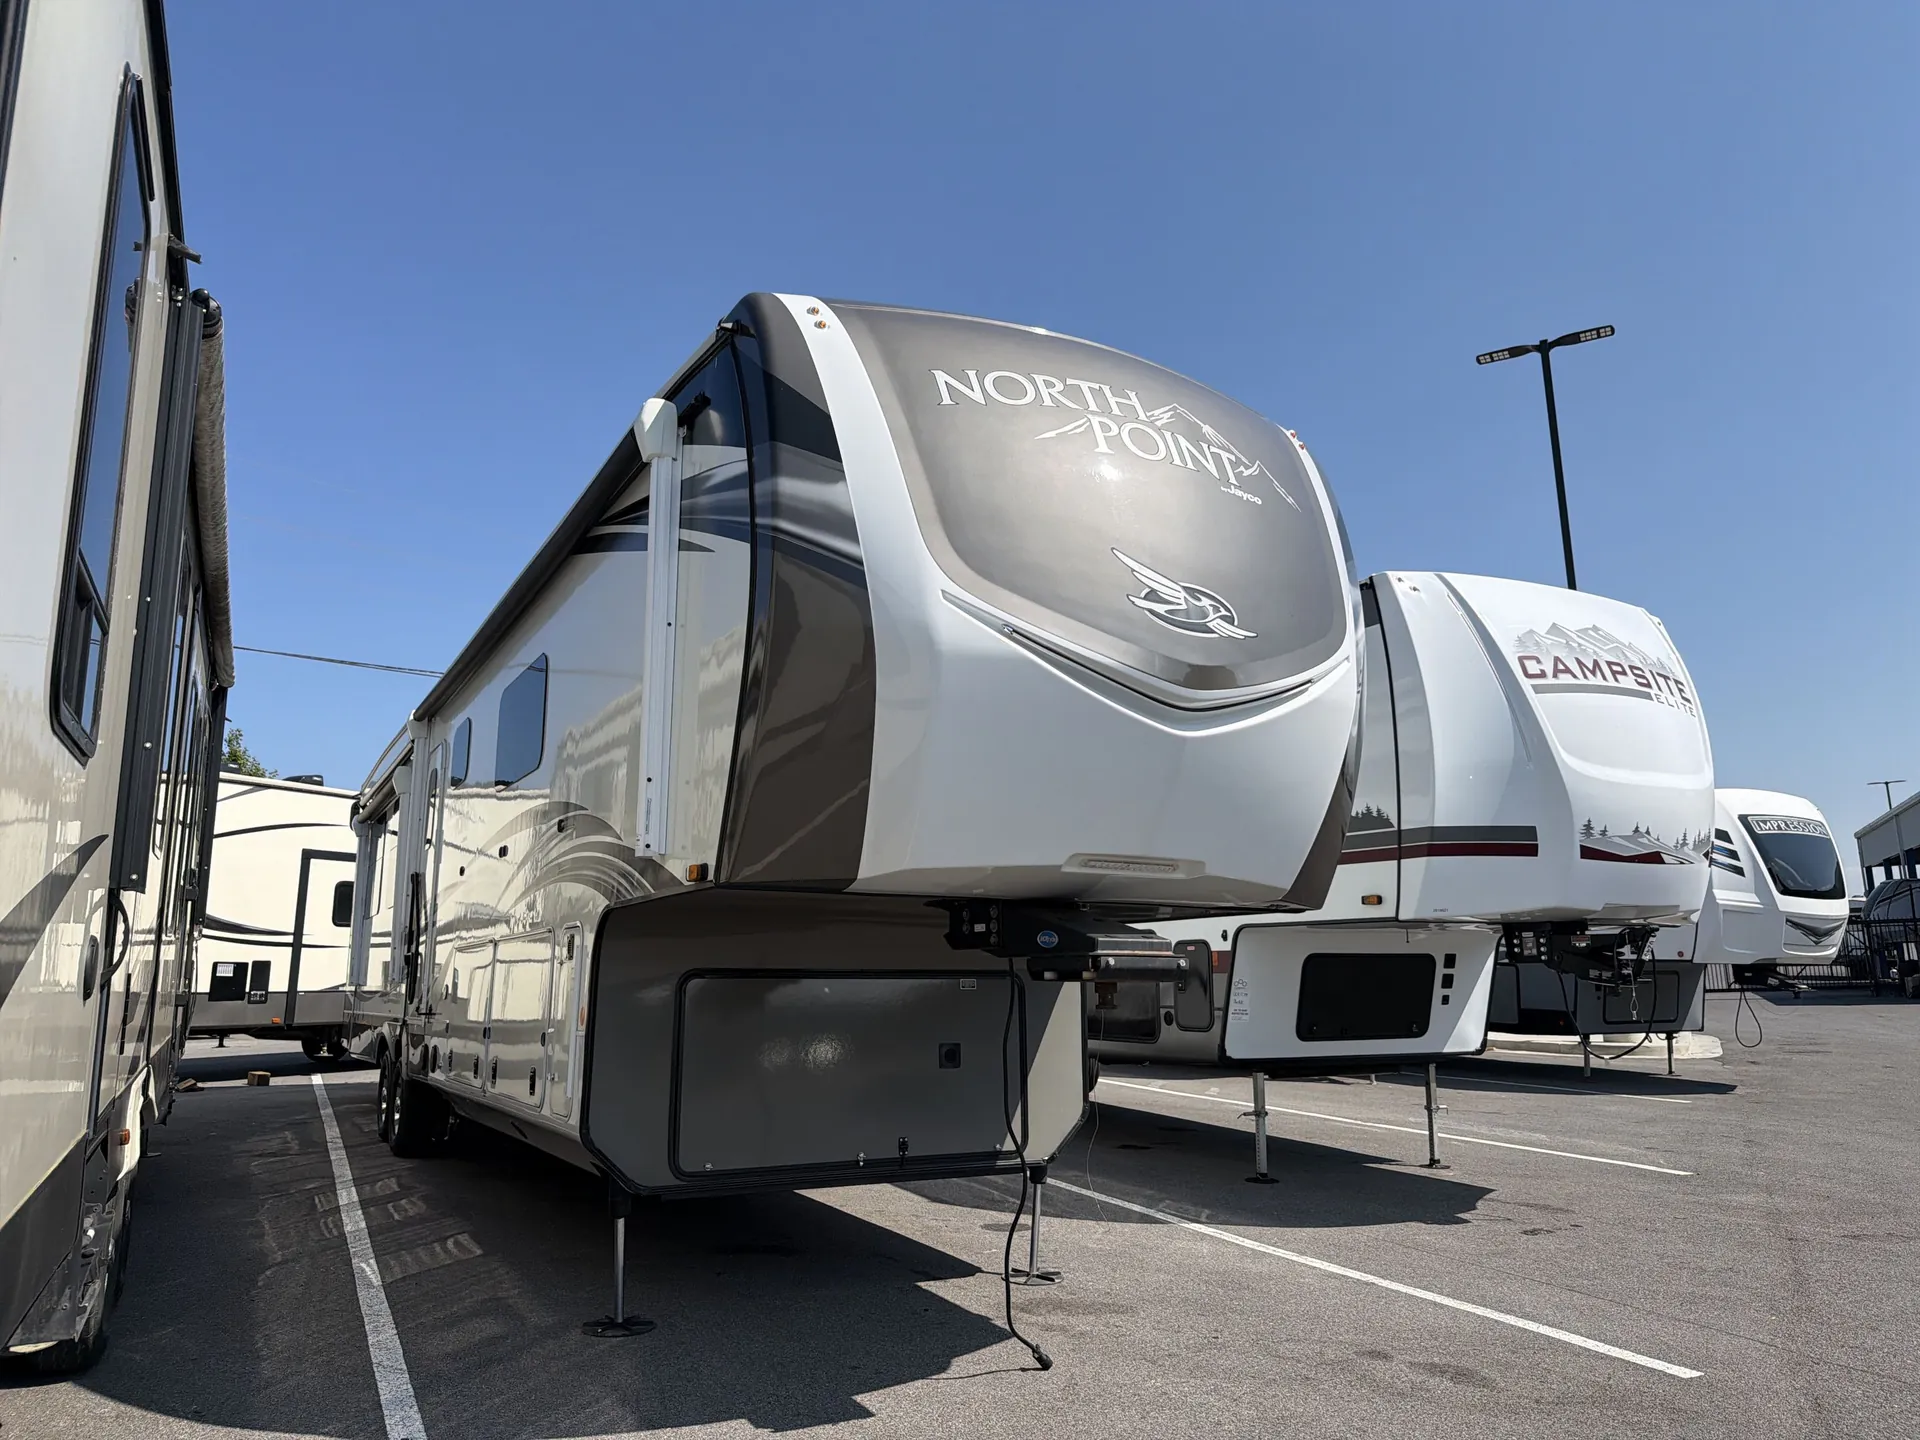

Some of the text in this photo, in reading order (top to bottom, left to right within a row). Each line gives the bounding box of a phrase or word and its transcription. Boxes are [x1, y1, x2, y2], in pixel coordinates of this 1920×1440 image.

[929, 369, 1150, 422] NORTH
[1084, 413, 1241, 488] POINT
[1228, 485, 1262, 505] Jayco
[1517, 655, 1693, 705] CAMPSITE
[1654, 693, 1696, 718] ELITE
[1752, 820, 1828, 836] IMPRESSION
